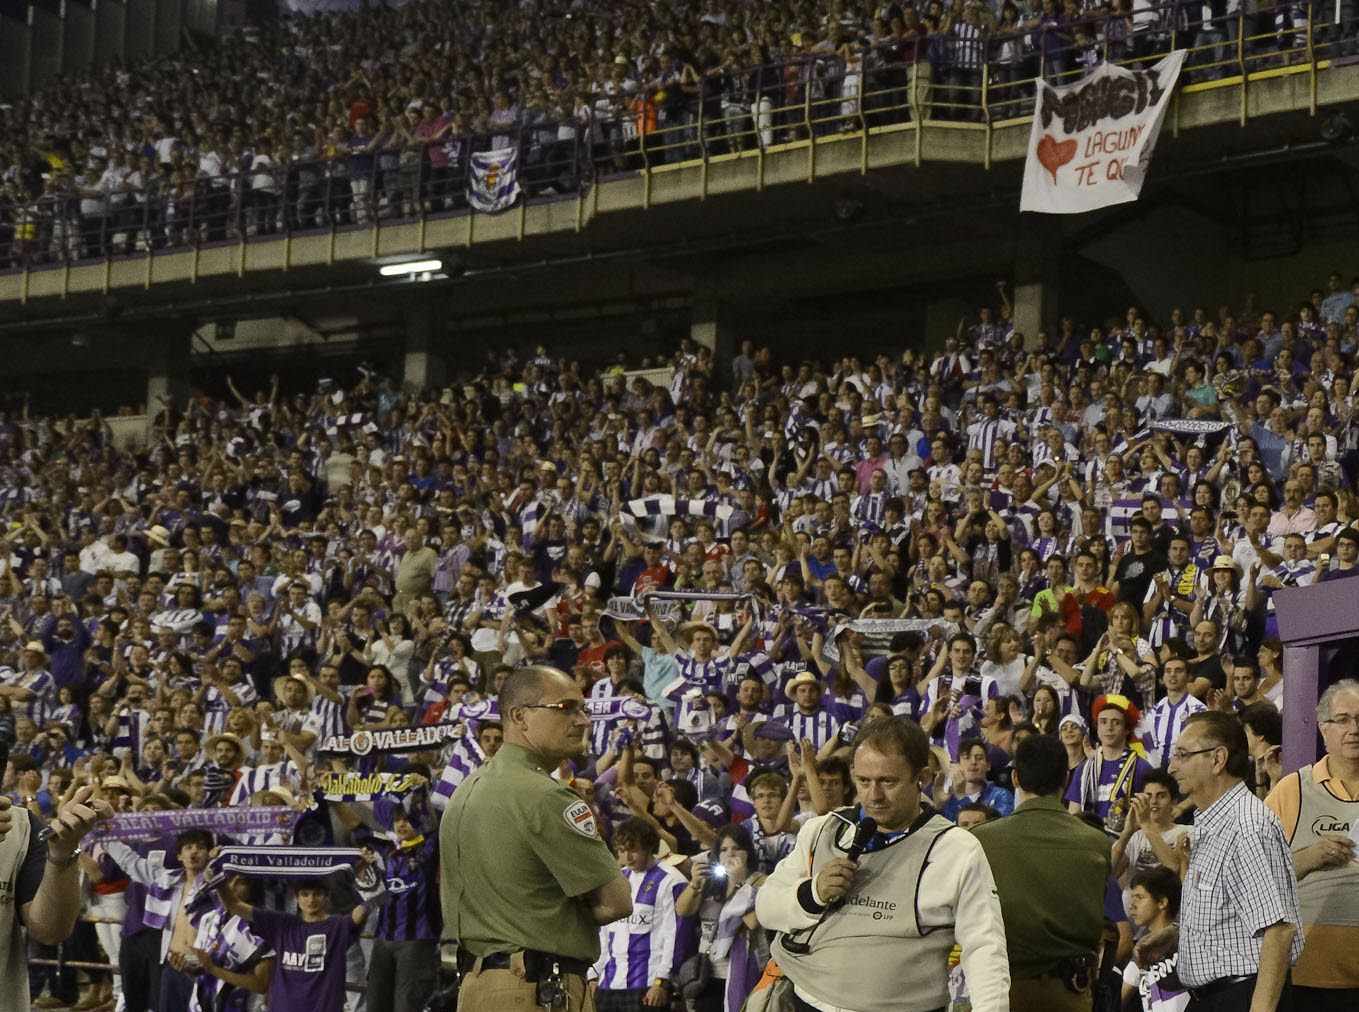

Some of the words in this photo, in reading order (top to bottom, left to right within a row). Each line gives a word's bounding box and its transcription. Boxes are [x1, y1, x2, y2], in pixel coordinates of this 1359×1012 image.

[1075, 161, 1099, 187] TE
[1320, 822, 1350, 831] LIGA
[230, 855, 260, 866] Real
[267, 856, 334, 867] Valladolid
